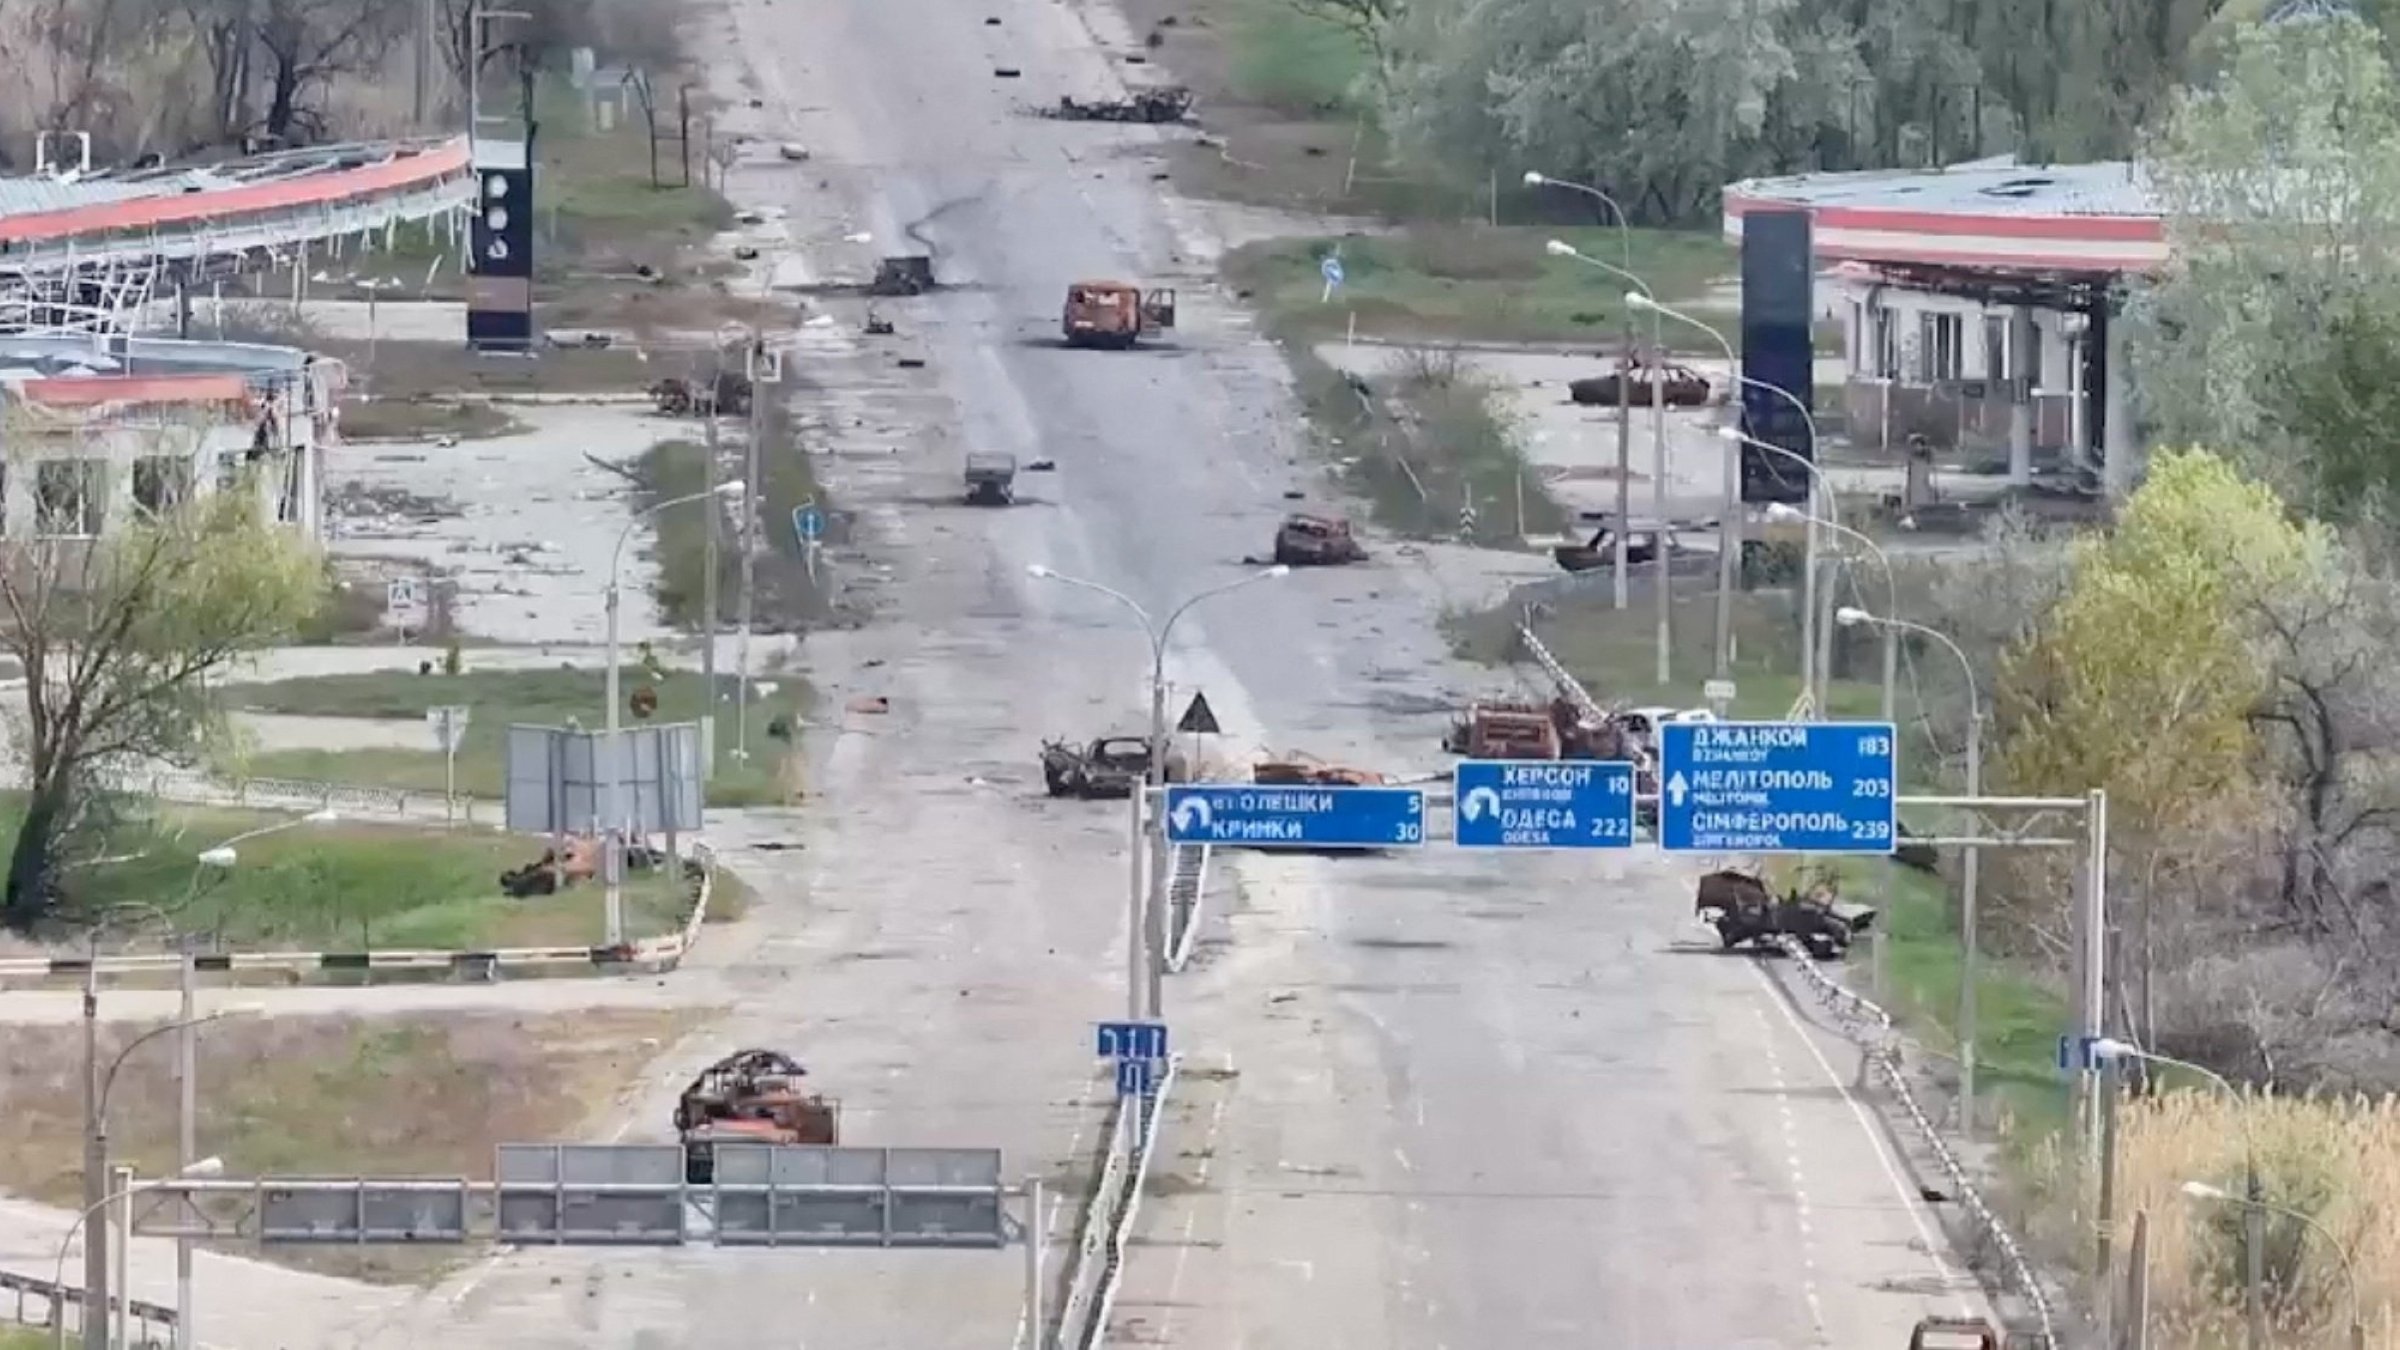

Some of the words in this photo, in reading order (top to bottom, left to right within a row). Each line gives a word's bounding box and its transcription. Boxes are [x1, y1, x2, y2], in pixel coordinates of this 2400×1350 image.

[1693, 728, 1807, 746] ДЖАНКОЙ
[1858, 736, 1889, 756] 183
[1503, 767, 1591, 786] ХЕРСОН
[1608, 776, 1629, 795] 10
[1692, 770, 1833, 789] МЕЛІТОПОЛЬ
[1852, 779, 1889, 797] 203
[1240, 793, 1333, 812] ОЛЕШКИ
[1407, 796, 1420, 814] 5
[1212, 819, 1303, 839] КРИНКИ
[1395, 823, 1419, 841] 30
[1501, 809, 1576, 829] ОДЕСА
[1591, 818, 1629, 837] 222
[1692, 813, 1848, 831] СІМФЕРОПОЛЬ
[1852, 821, 1889, 839] 239
